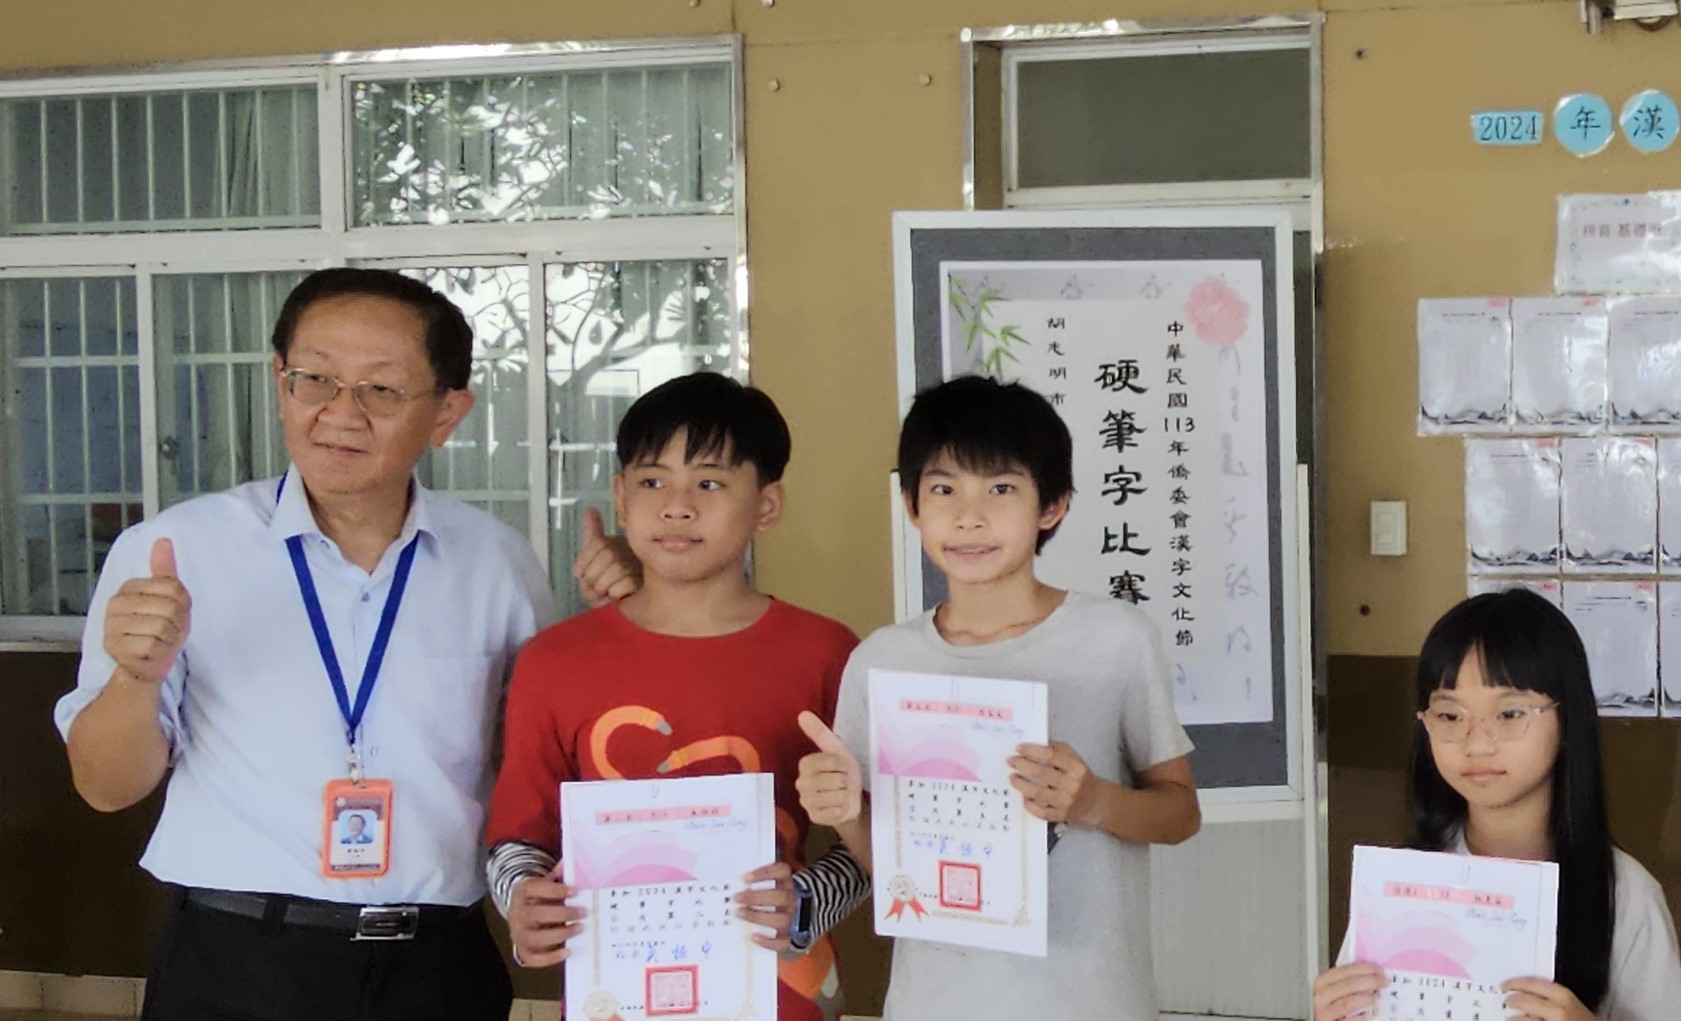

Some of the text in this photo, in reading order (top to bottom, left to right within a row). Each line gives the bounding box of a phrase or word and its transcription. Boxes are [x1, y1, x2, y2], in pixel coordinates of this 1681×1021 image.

[1093, 358, 1153, 605] 硬筆字比賽
